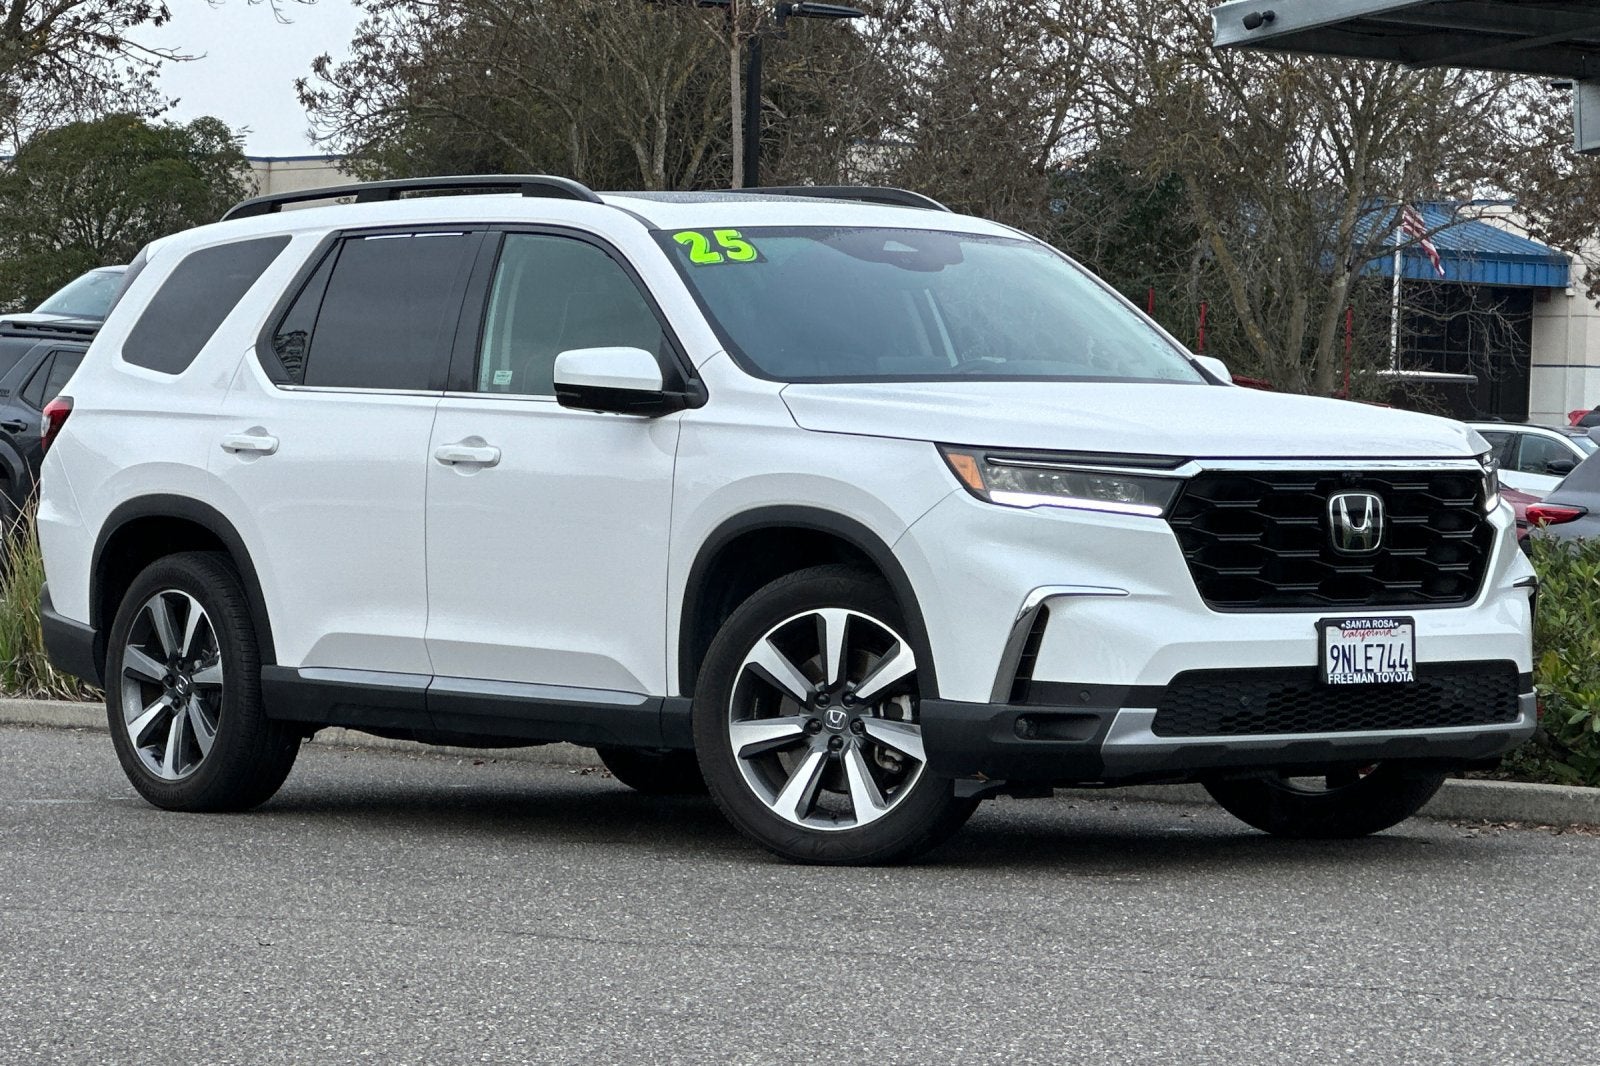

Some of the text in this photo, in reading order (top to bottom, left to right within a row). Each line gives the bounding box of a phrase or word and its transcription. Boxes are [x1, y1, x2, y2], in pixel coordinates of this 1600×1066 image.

[673, 229, 757, 263] 25
[1345, 620, 1394, 629] SANTA ROSA
[1342, 628, 1392, 642] California
[1330, 643, 1408, 673] 9NLE744
[1328, 671, 1414, 684] FREEMAN TOYOTA
